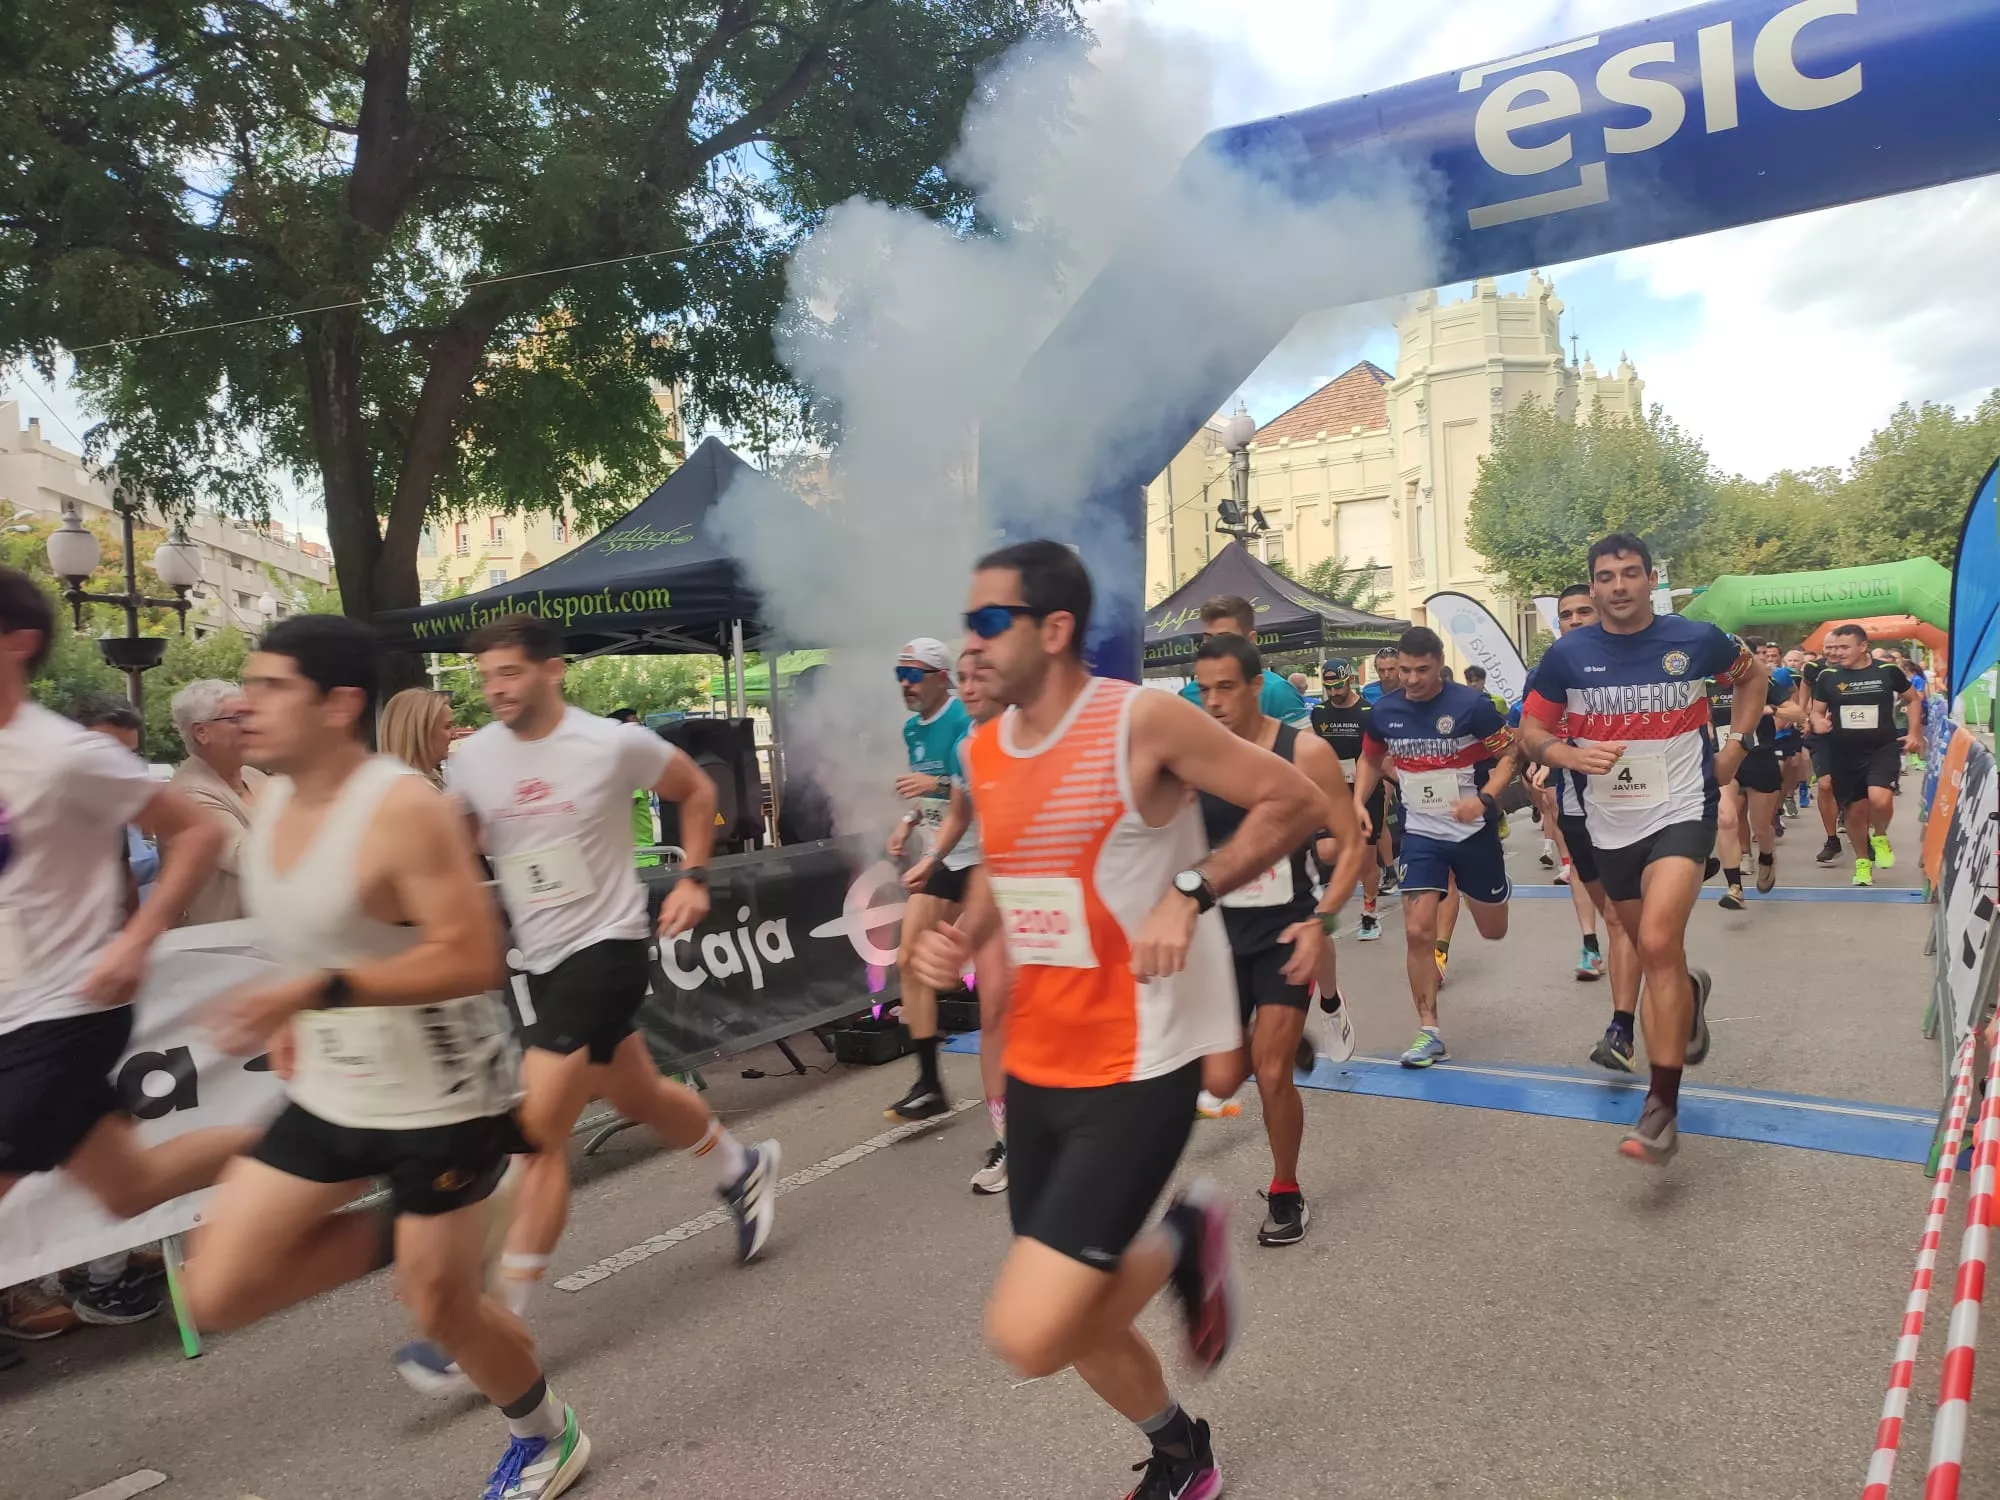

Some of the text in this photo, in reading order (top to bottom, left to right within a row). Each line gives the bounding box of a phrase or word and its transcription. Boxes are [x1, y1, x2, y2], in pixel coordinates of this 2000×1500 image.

[1750, 583, 1834, 607] FARTLECK
[1839, 577, 1894, 601] SPORT
[1582, 681, 1690, 715] BOMBEROS
[1850, 711, 1865, 720] 64
[1617, 767, 1633, 783] 4
[1423, 786, 1434, 798] 5
[1612, 783, 1647, 791] JAVIER
